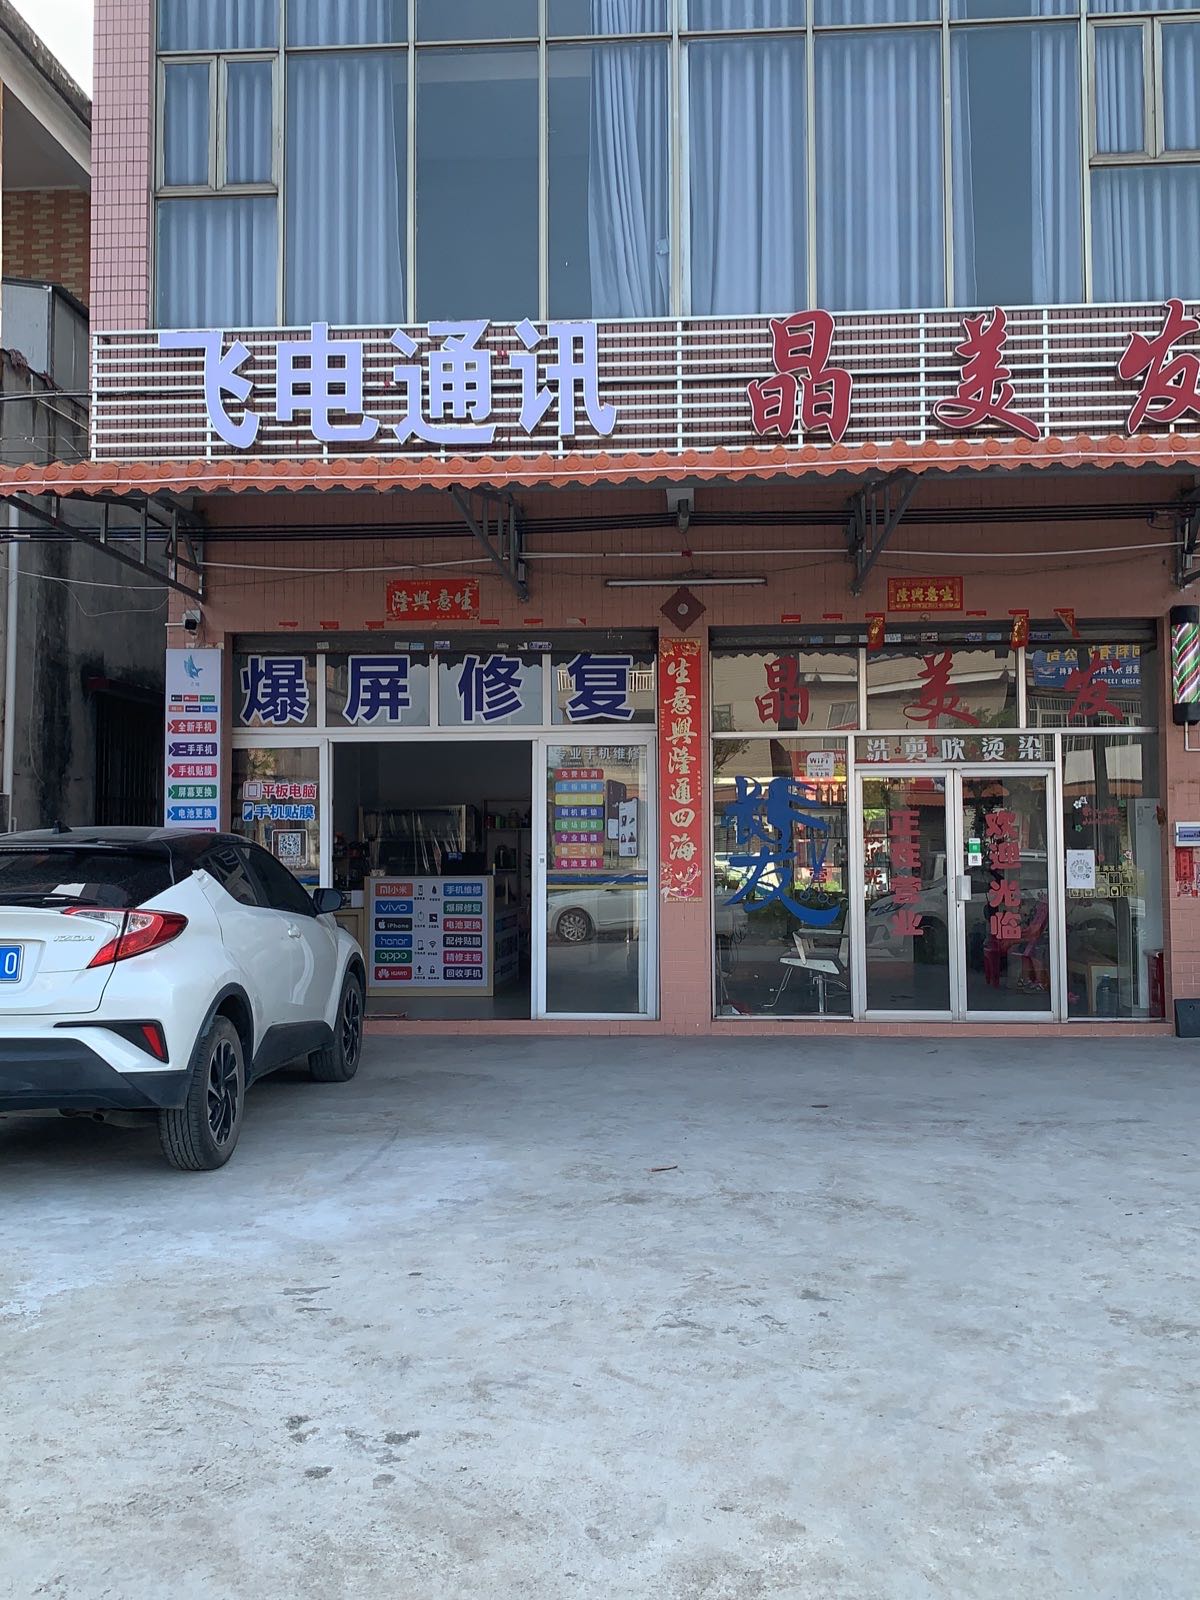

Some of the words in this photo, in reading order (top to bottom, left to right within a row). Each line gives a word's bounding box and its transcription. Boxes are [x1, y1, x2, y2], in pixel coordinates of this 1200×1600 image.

[158, 317, 617, 449] 飞电通讯
[239, 652, 634, 725] 爆屏修复
[178, 721, 213, 733] 全新手机
[178, 743, 213, 755] 二手手机
[866, 735, 1043, 761] 洗剪吹烫染
[178, 765, 213, 777] 手机贴膜
[178, 786, 213, 797] 屏幕更换
[262, 782, 317, 800] 平板电脑
[178, 807, 213, 819] 电池更换
[254, 803, 316, 821] 手机贴膜
[888, 810, 924, 937] 正在营业
[985, 810, 1022, 940] 欢迎光临
[380, 901, 408, 912] vivo
[446, 920, 481, 930] 电池更换
[380, 936, 408, 945] honor
[380, 952, 408, 962] oppo
[446, 968, 482, 978] 回收手机
